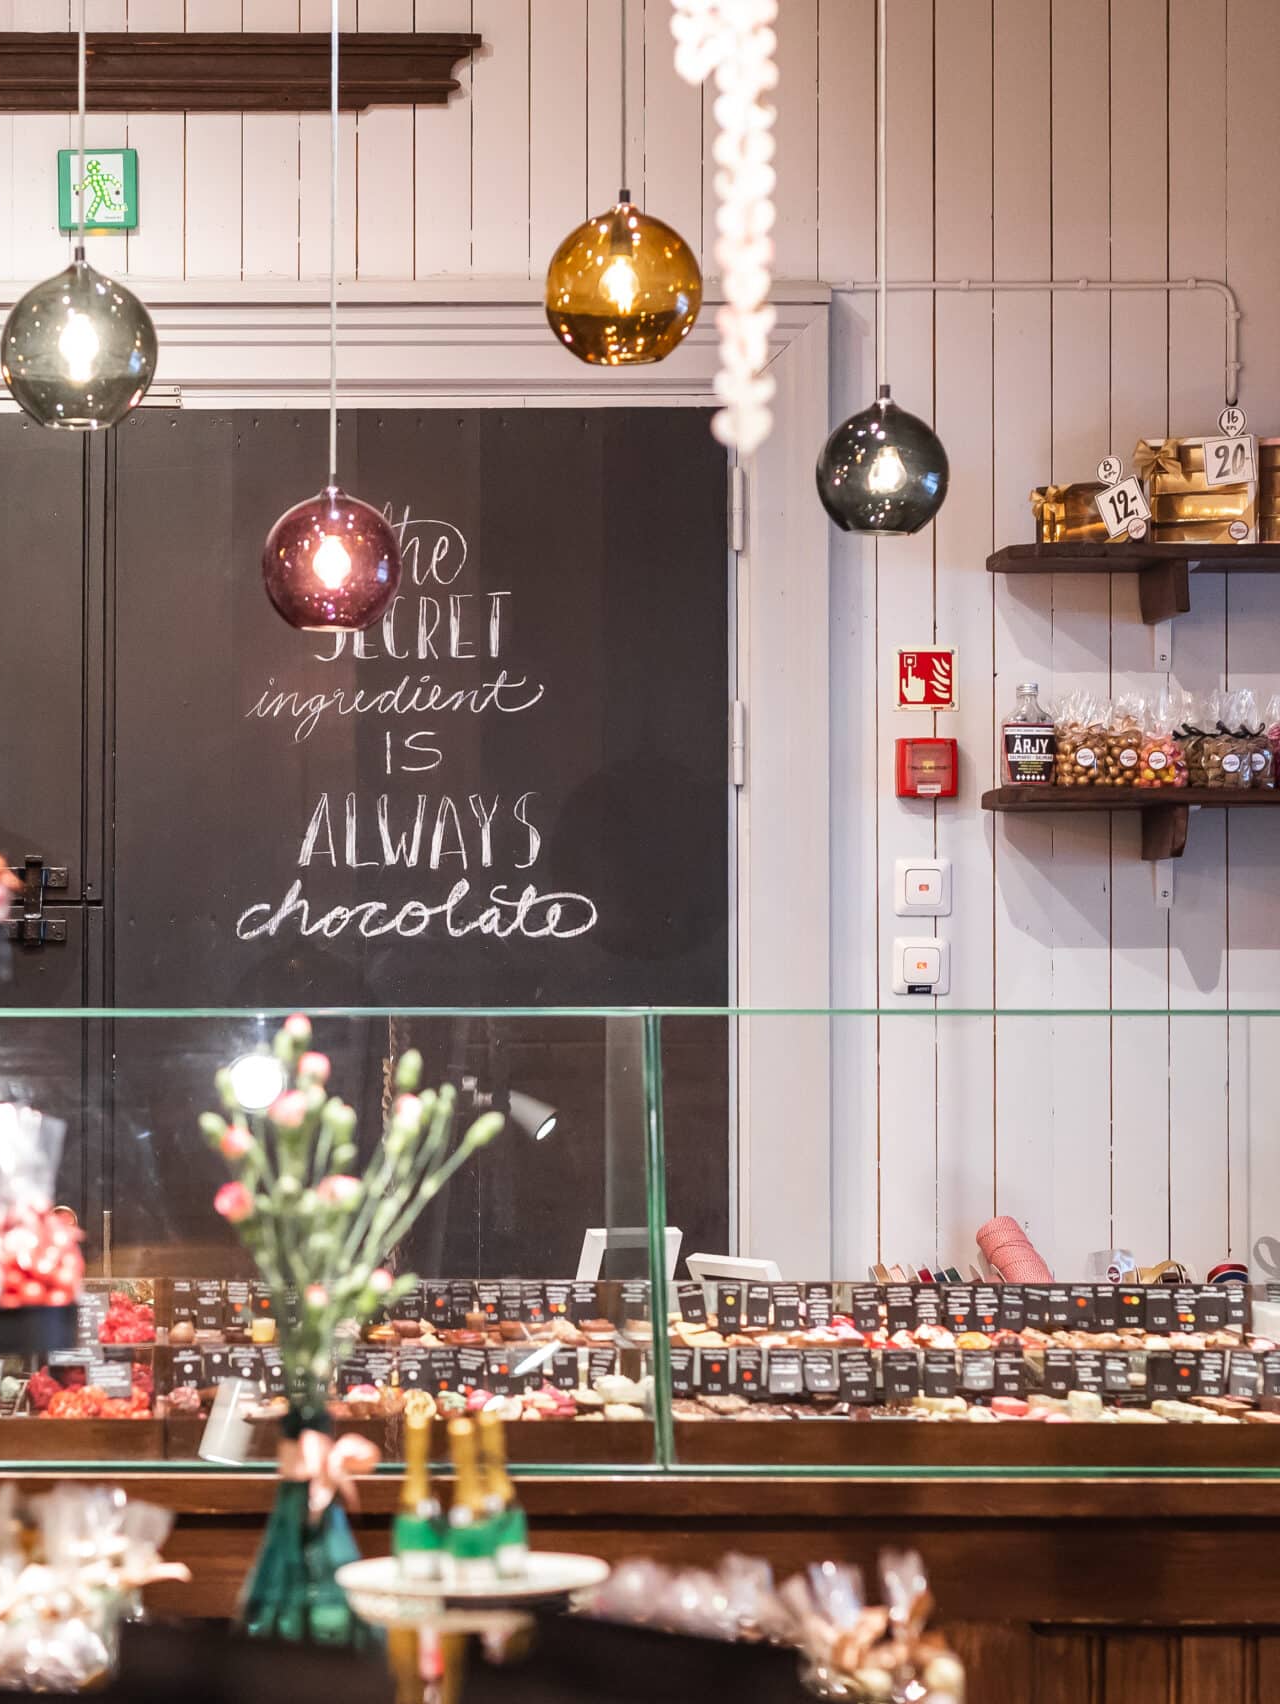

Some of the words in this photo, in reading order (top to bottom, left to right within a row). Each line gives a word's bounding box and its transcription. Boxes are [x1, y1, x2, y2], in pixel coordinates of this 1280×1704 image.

[1102, 460, 1114, 472] 8
[245, 670, 546, 743] ingredient
[385, 731, 444, 774] IS
[1013, 735, 1049, 754] ÄRJY
[297, 792, 542, 869] ALWAYS
[236, 879, 599, 940] chocolate
